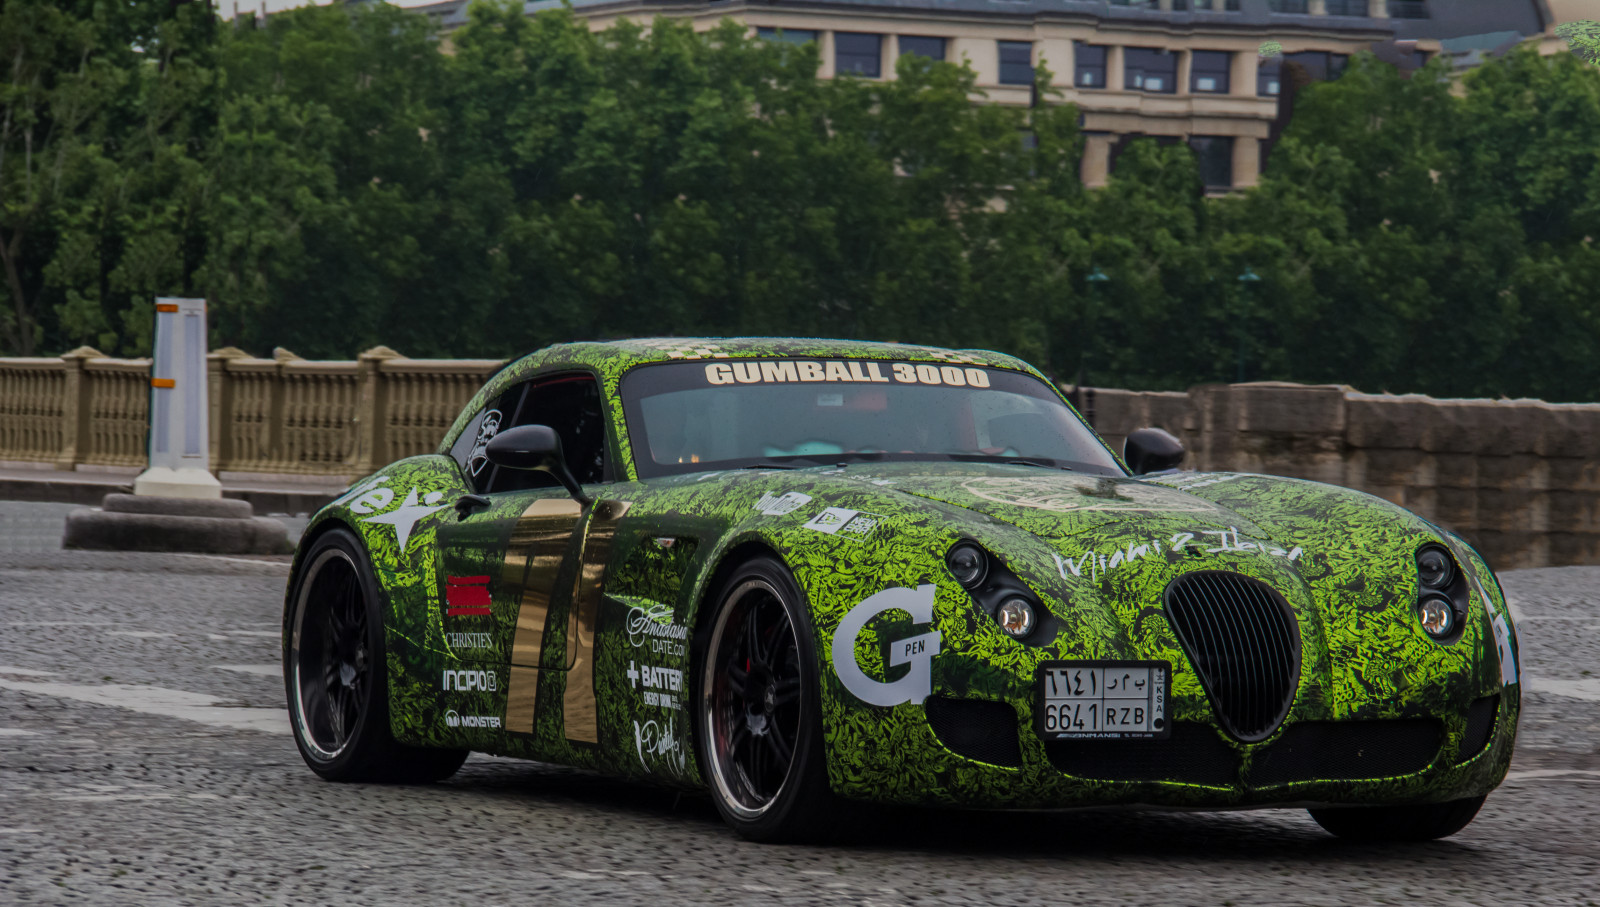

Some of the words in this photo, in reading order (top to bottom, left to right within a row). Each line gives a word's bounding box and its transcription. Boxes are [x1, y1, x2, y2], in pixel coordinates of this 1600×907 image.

[705, 361, 889, 385] GUMBALL
[892, 363, 990, 388] 3000
[445, 632, 493, 649] CHRISTIE'S
[832, 584, 941, 707] G
[905, 640, 925, 656] PEN
[461, 715, 502, 728] MONSTER
[1045, 703, 1098, 730] 6641
[1106, 707, 1145, 726] RZB
